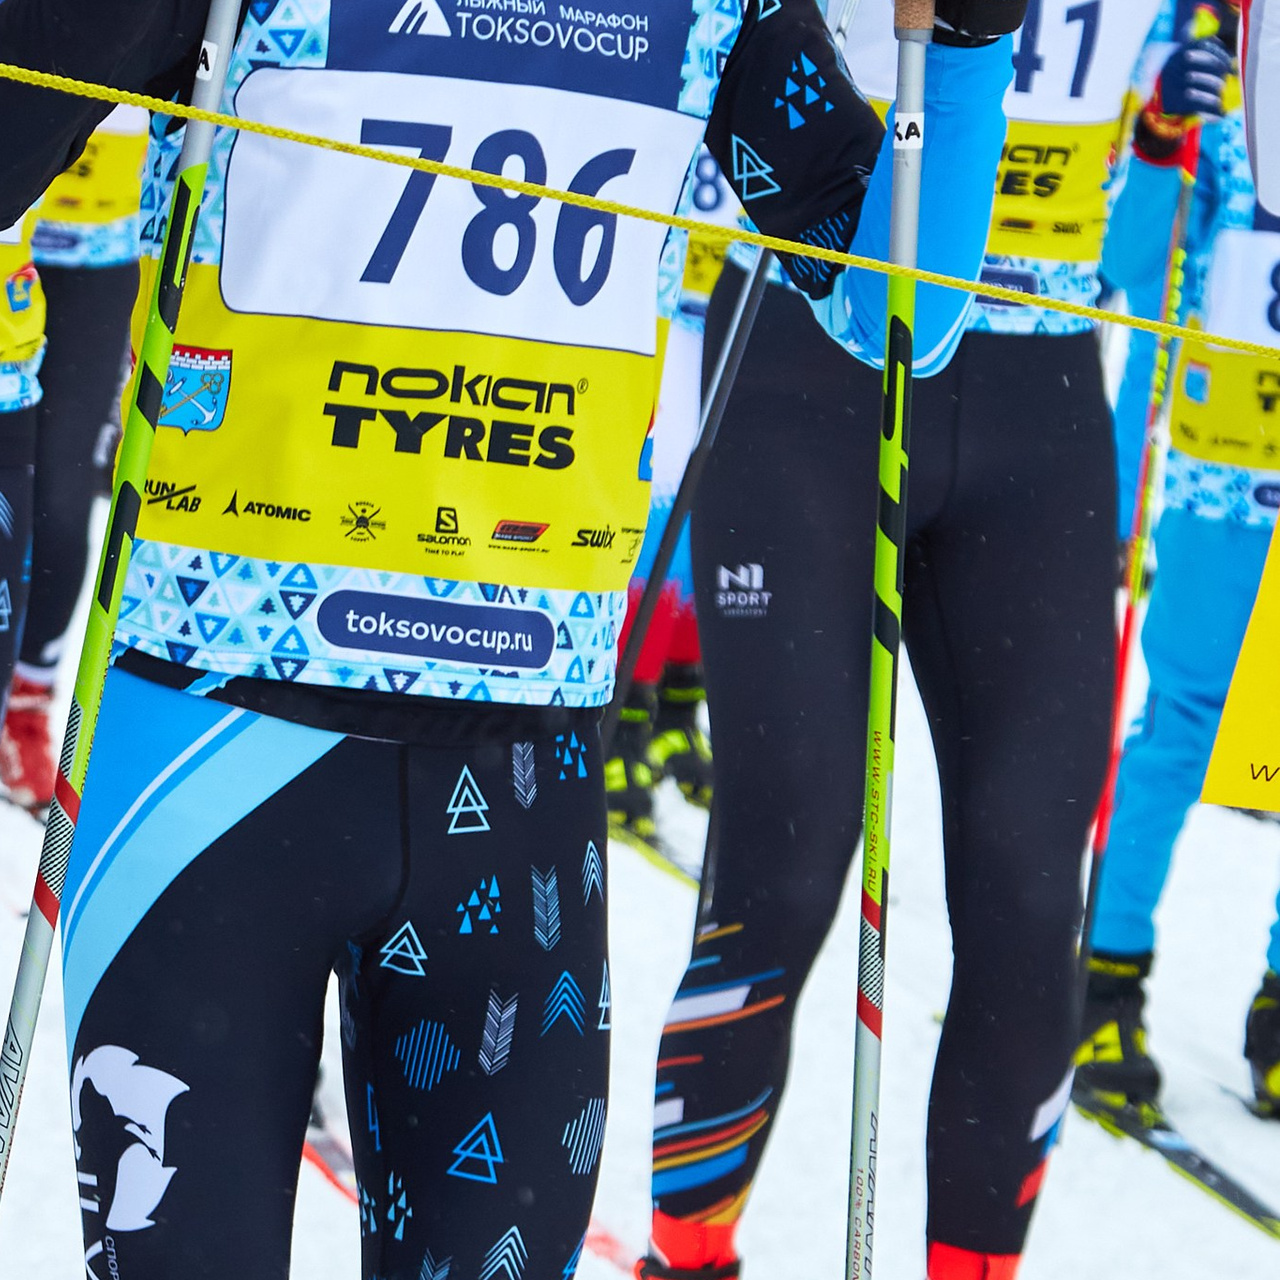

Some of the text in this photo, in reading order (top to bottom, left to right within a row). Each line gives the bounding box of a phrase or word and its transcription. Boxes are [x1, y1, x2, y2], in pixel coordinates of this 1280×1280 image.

[456, 11, 649, 62] TOKSOVOCUP
[559, 5, 649, 33] МАРАФОН
[359, 118, 637, 307] 786
[323, 402, 575, 470] TYRES
[166, 495, 202, 513] LAB
[243, 501, 312, 522] ATOMIC
[717, 591, 773, 606] SPORT
[346, 609, 533, 654] toksovocup.ru
[867, 730, 882, 892] WWW.STC-SKI.RU
